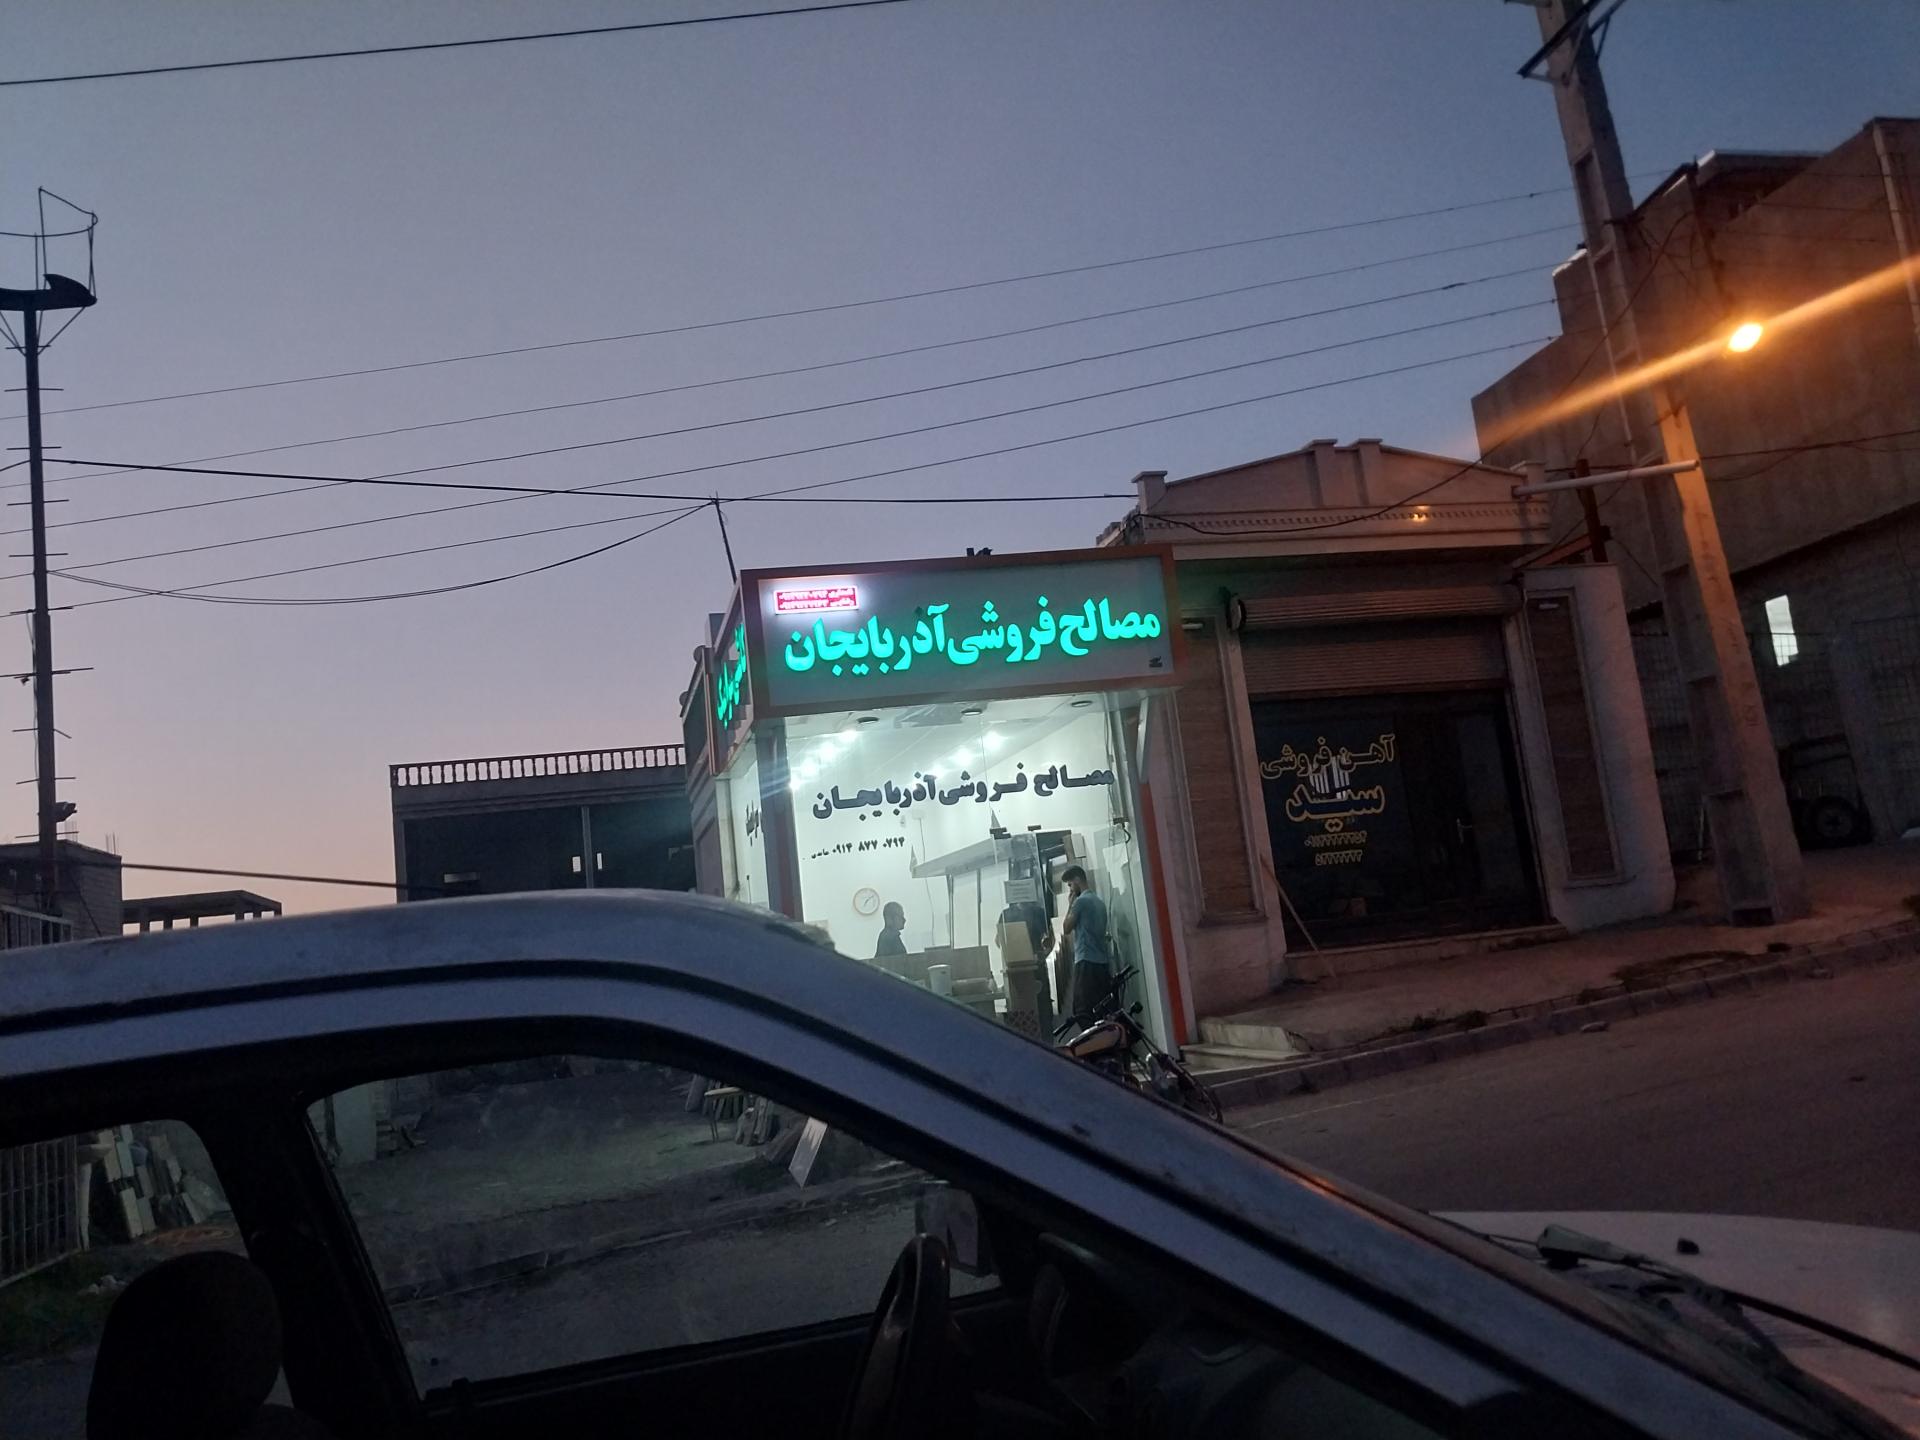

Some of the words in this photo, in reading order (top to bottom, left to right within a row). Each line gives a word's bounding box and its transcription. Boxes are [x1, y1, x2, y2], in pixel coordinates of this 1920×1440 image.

[947, 595, 1057, 666] فروشی
[1058, 597, 1161, 656] مصالح
[1260, 736, 1332, 780] فروشی
[1338, 733, 1396, 773] آهن
[812, 771, 937, 821] آذربایجان
[938, 762, 1028, 806] فروشی
[1033, 764, 1115, 797] مصالح
